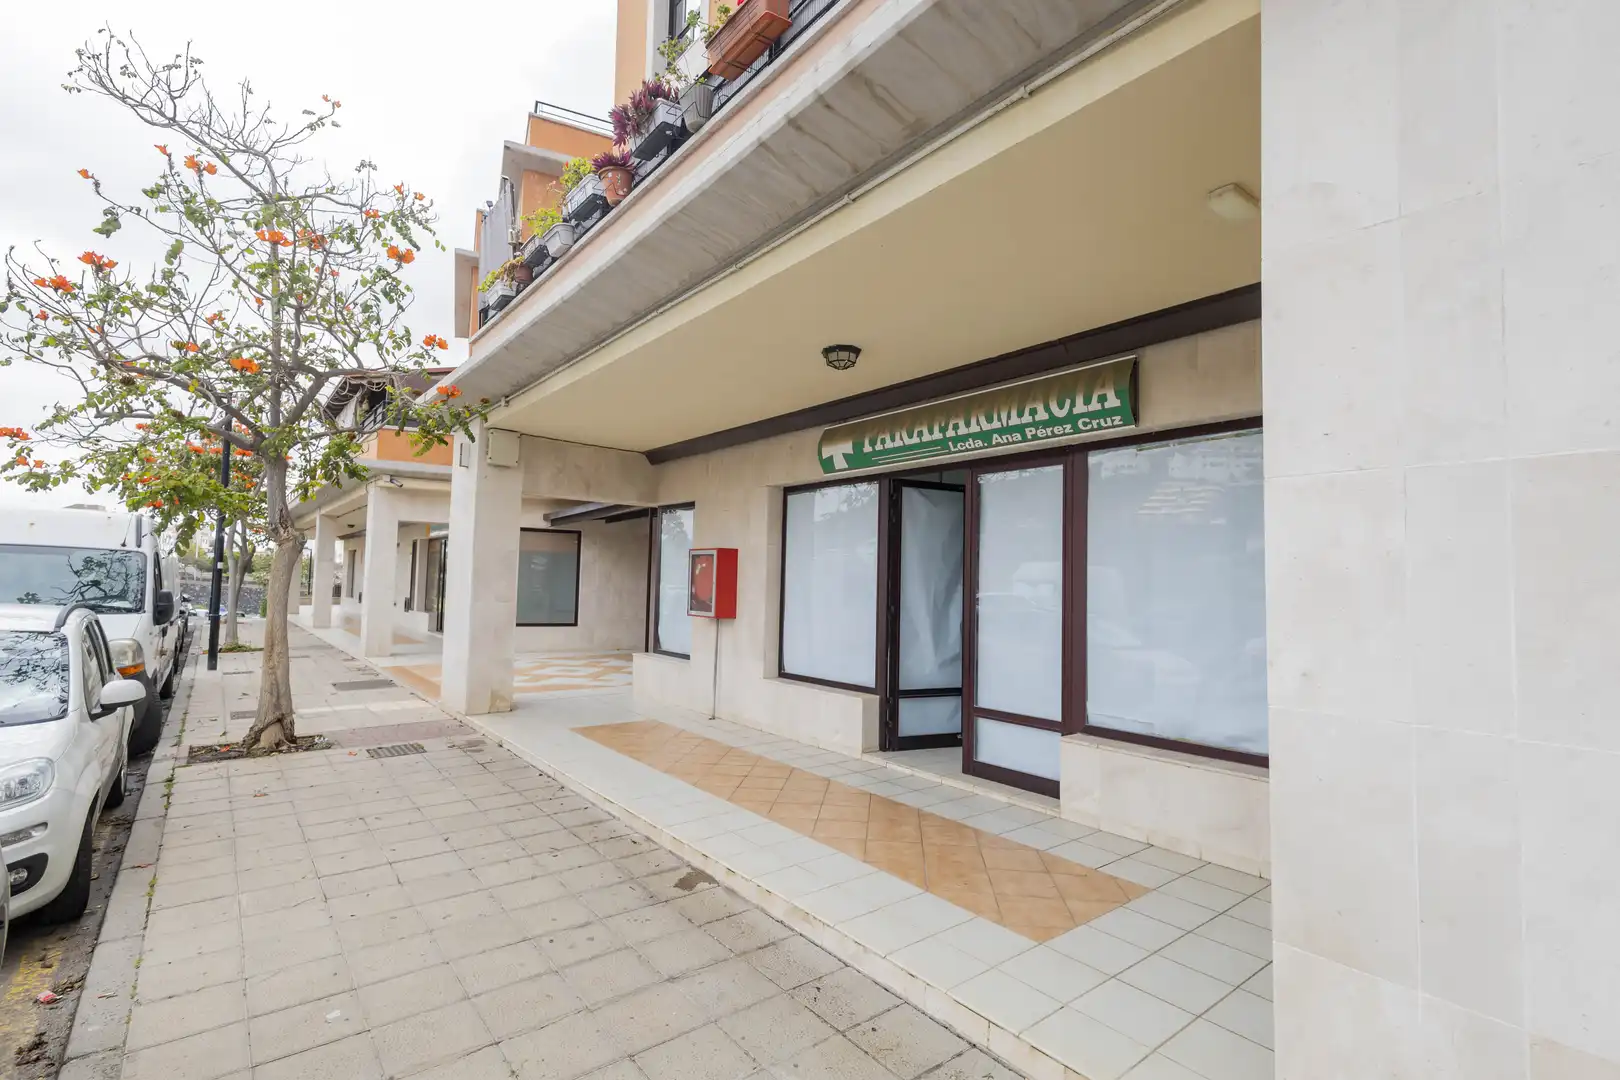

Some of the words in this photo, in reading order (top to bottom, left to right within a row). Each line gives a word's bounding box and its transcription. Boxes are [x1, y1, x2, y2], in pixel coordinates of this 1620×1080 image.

[948, 439, 988, 452] Lcda.
[992, 433, 1023, 445] Ana
[1024, 424, 1074, 440] Pérez
[1078, 415, 1124, 431] Cruz
